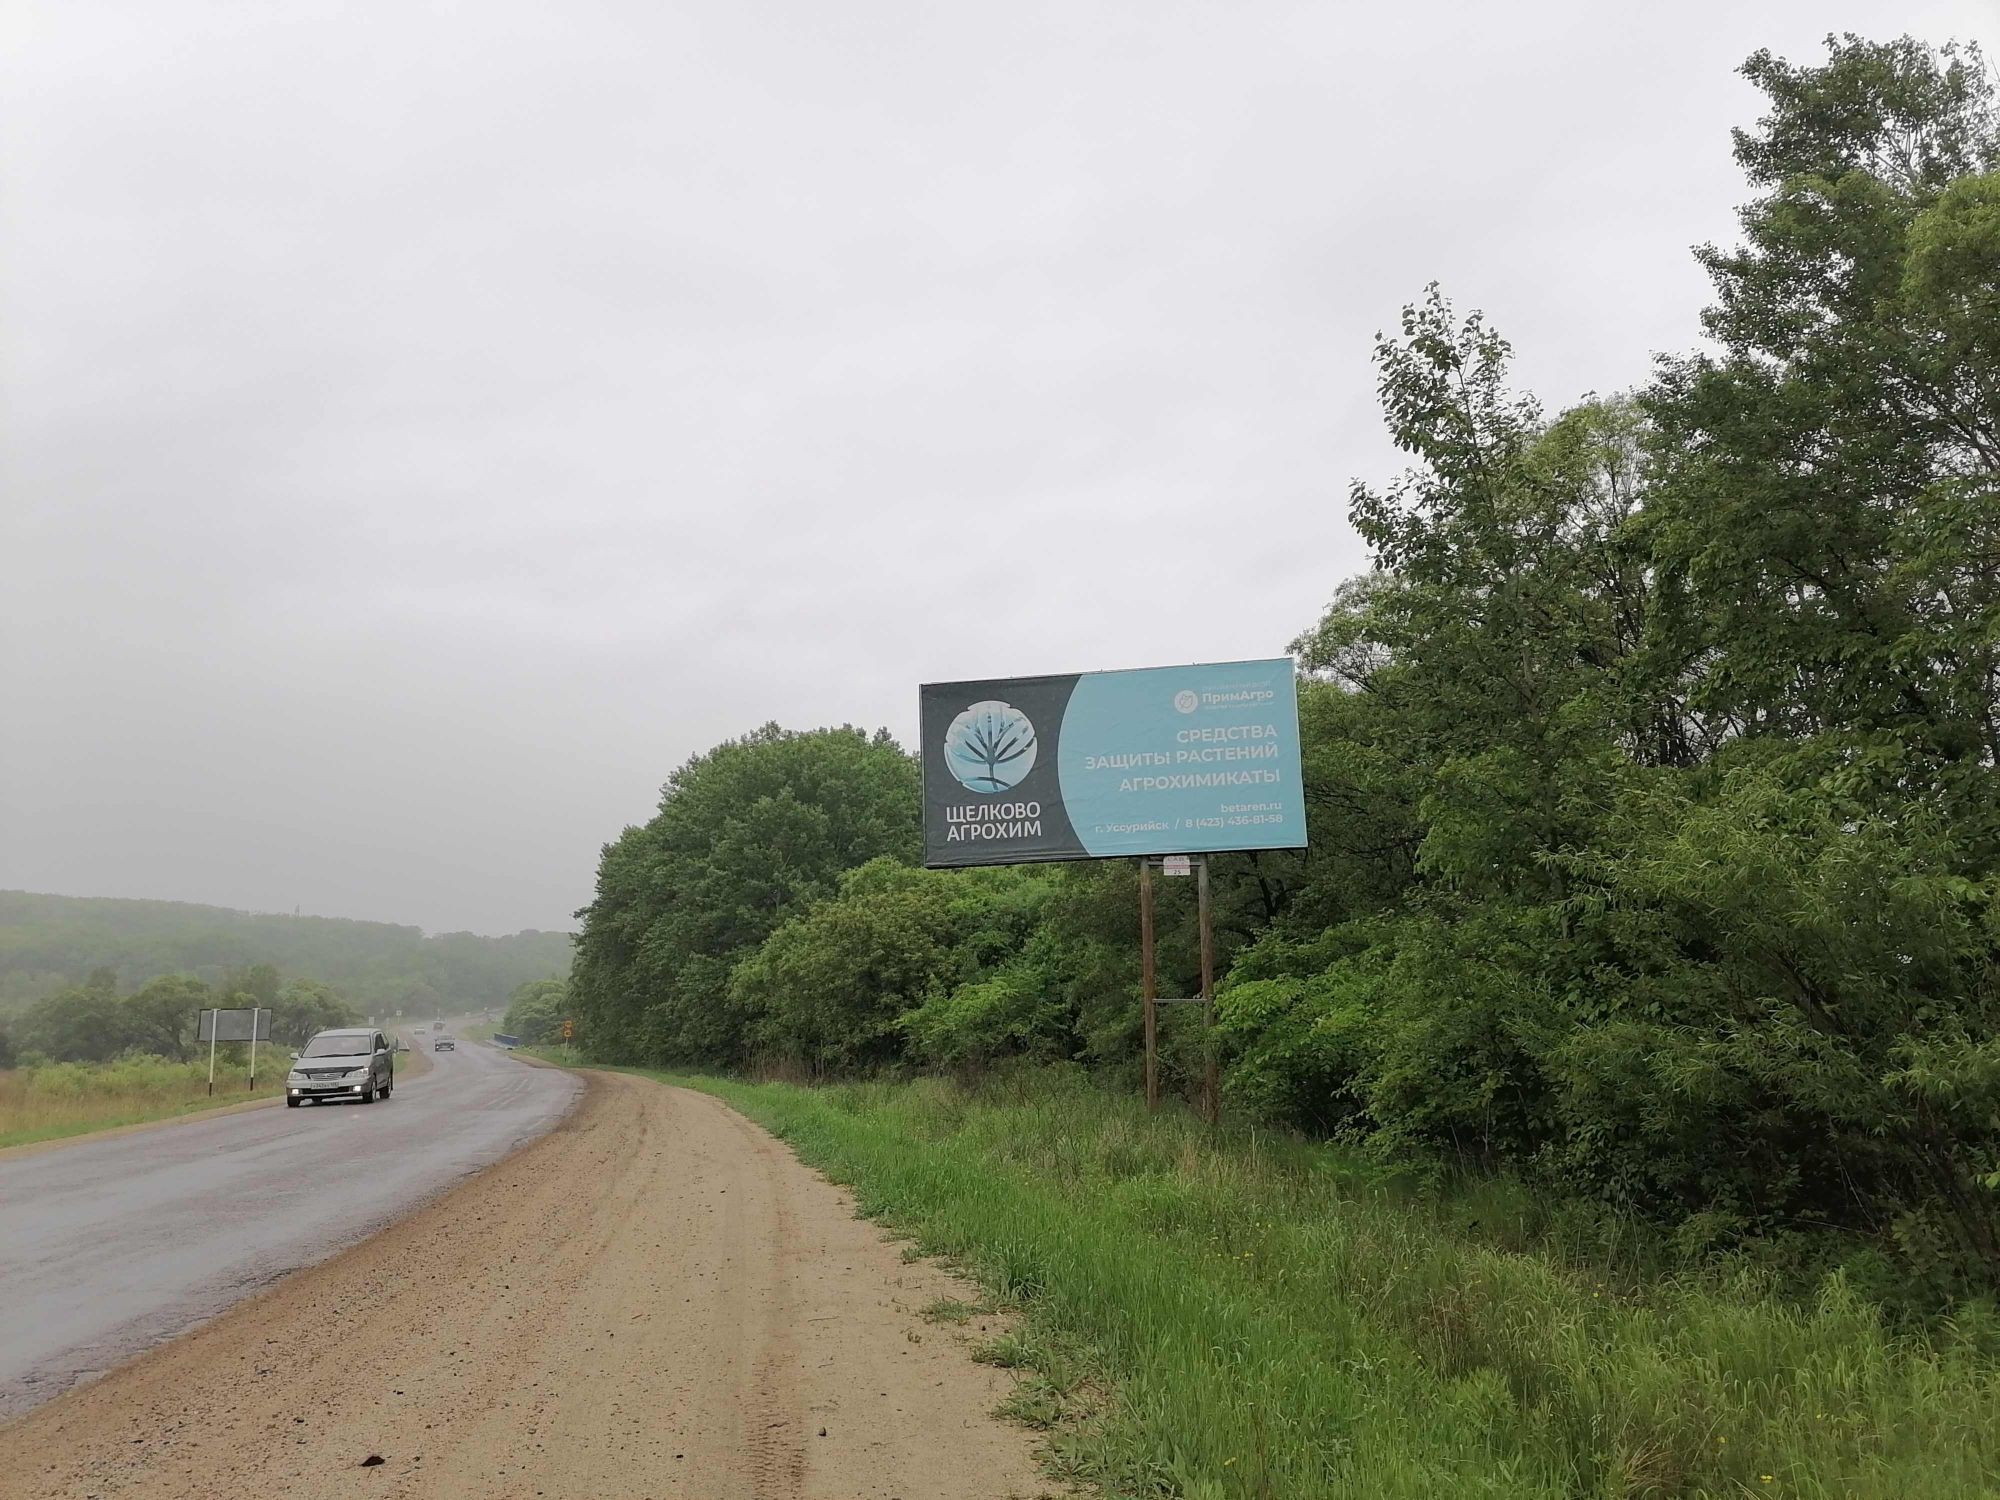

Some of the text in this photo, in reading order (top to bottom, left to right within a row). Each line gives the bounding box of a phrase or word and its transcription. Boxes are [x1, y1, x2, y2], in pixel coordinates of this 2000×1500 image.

[1202, 690, 1274, 704] ПримАгро
[1176, 724, 1278, 743] СРЕДСТВА
[1085, 741, 1279, 770] ЗАЩИТЫ РАСТЕНИЙ
[1119, 769, 1281, 792] АГРОХИМИКАТЫ
[946, 801, 1041, 823] ЩЕЛКОВО
[1220, 802, 1283, 813] betaren.ru
[946, 820, 1042, 842] АГРОХИМ
[1095, 825, 1104, 833] г.
[1105, 820, 1170, 833] Уссурийск
[1185, 819, 1194, 828] 8
[1196, 817, 1225, 829] (423)
[1227, 813, 1284, 825] 436-81-58
